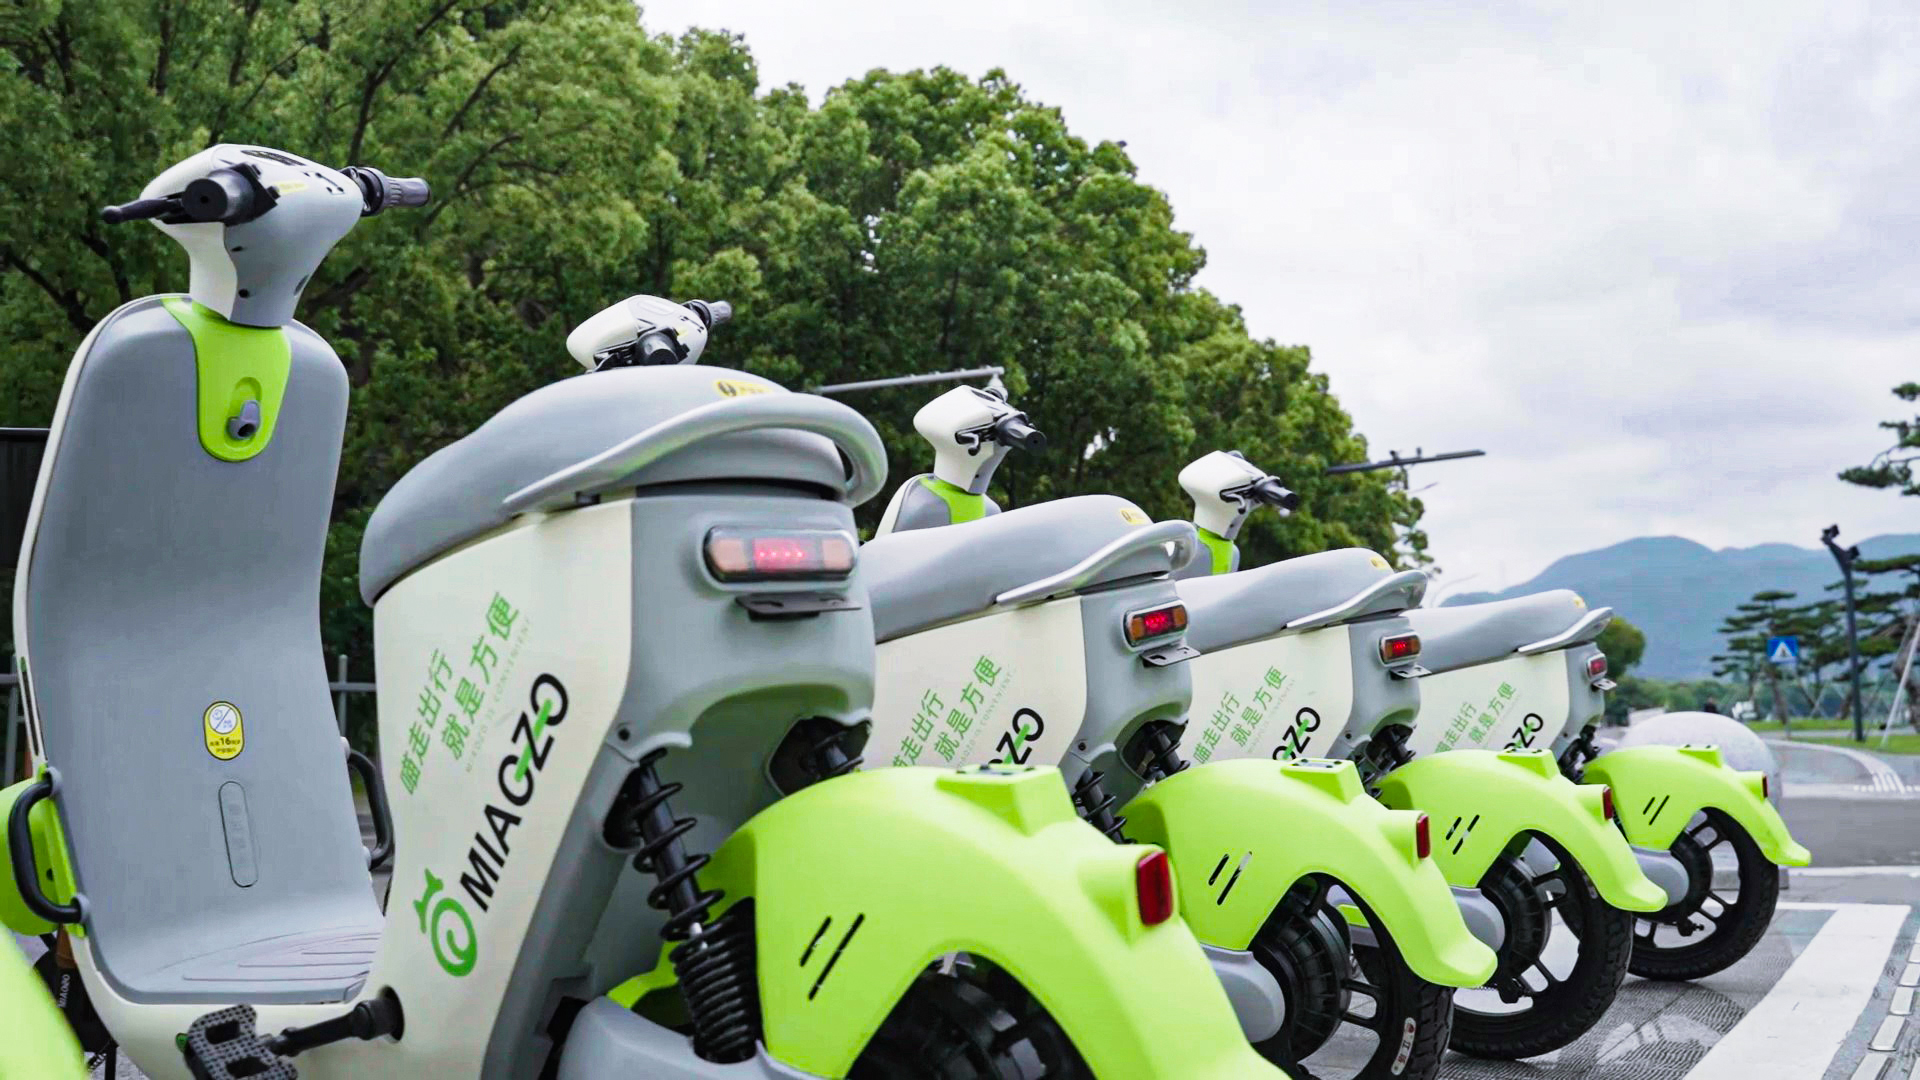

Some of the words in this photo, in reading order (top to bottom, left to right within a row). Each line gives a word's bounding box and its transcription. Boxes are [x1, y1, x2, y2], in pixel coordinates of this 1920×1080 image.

[441, 591, 519, 760] 就是方便
[934, 655, 1002, 762] 就是方便
[1230, 665, 1287, 748] 就是方便
